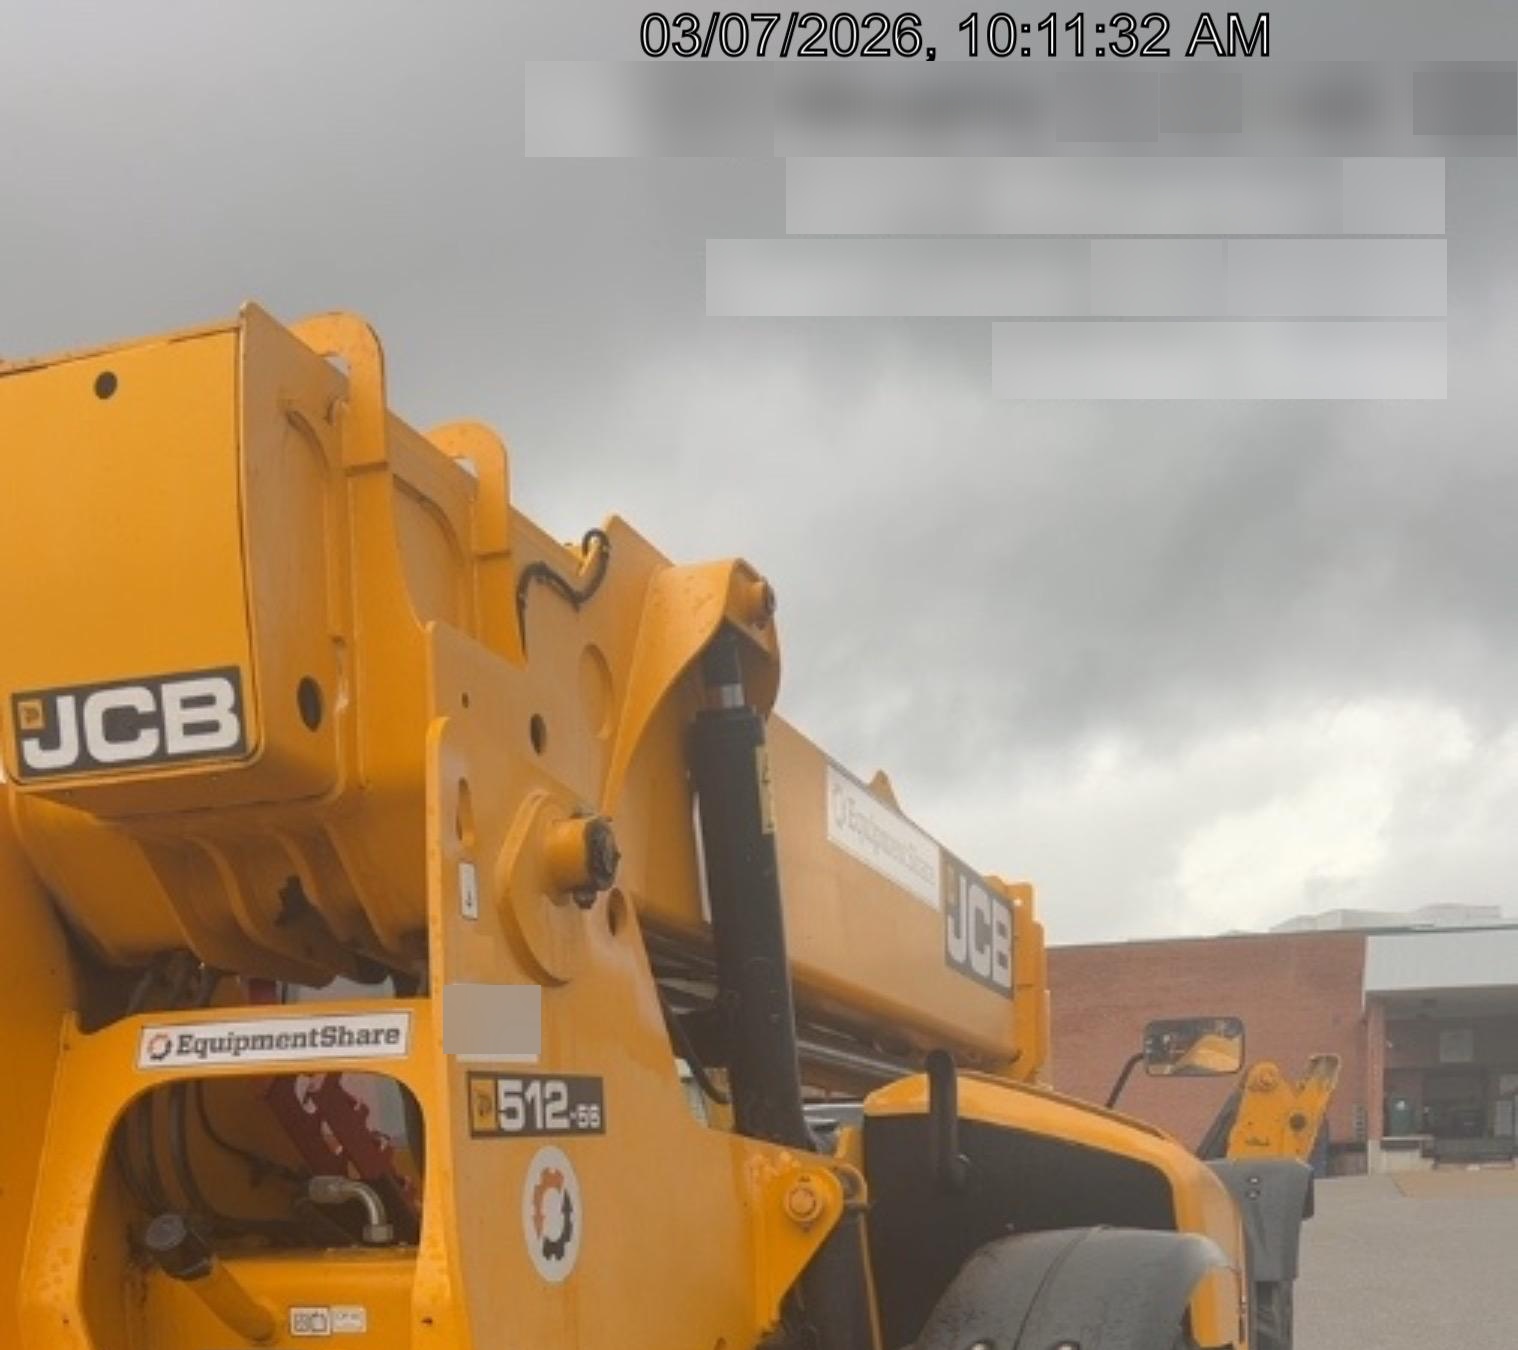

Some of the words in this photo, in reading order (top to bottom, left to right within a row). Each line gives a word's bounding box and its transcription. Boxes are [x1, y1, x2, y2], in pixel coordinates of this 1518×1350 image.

[22, 677, 241, 770] JCB
[947, 873, 1013, 989] JCB
[176, 1024, 401, 1059] EquipmentShare
